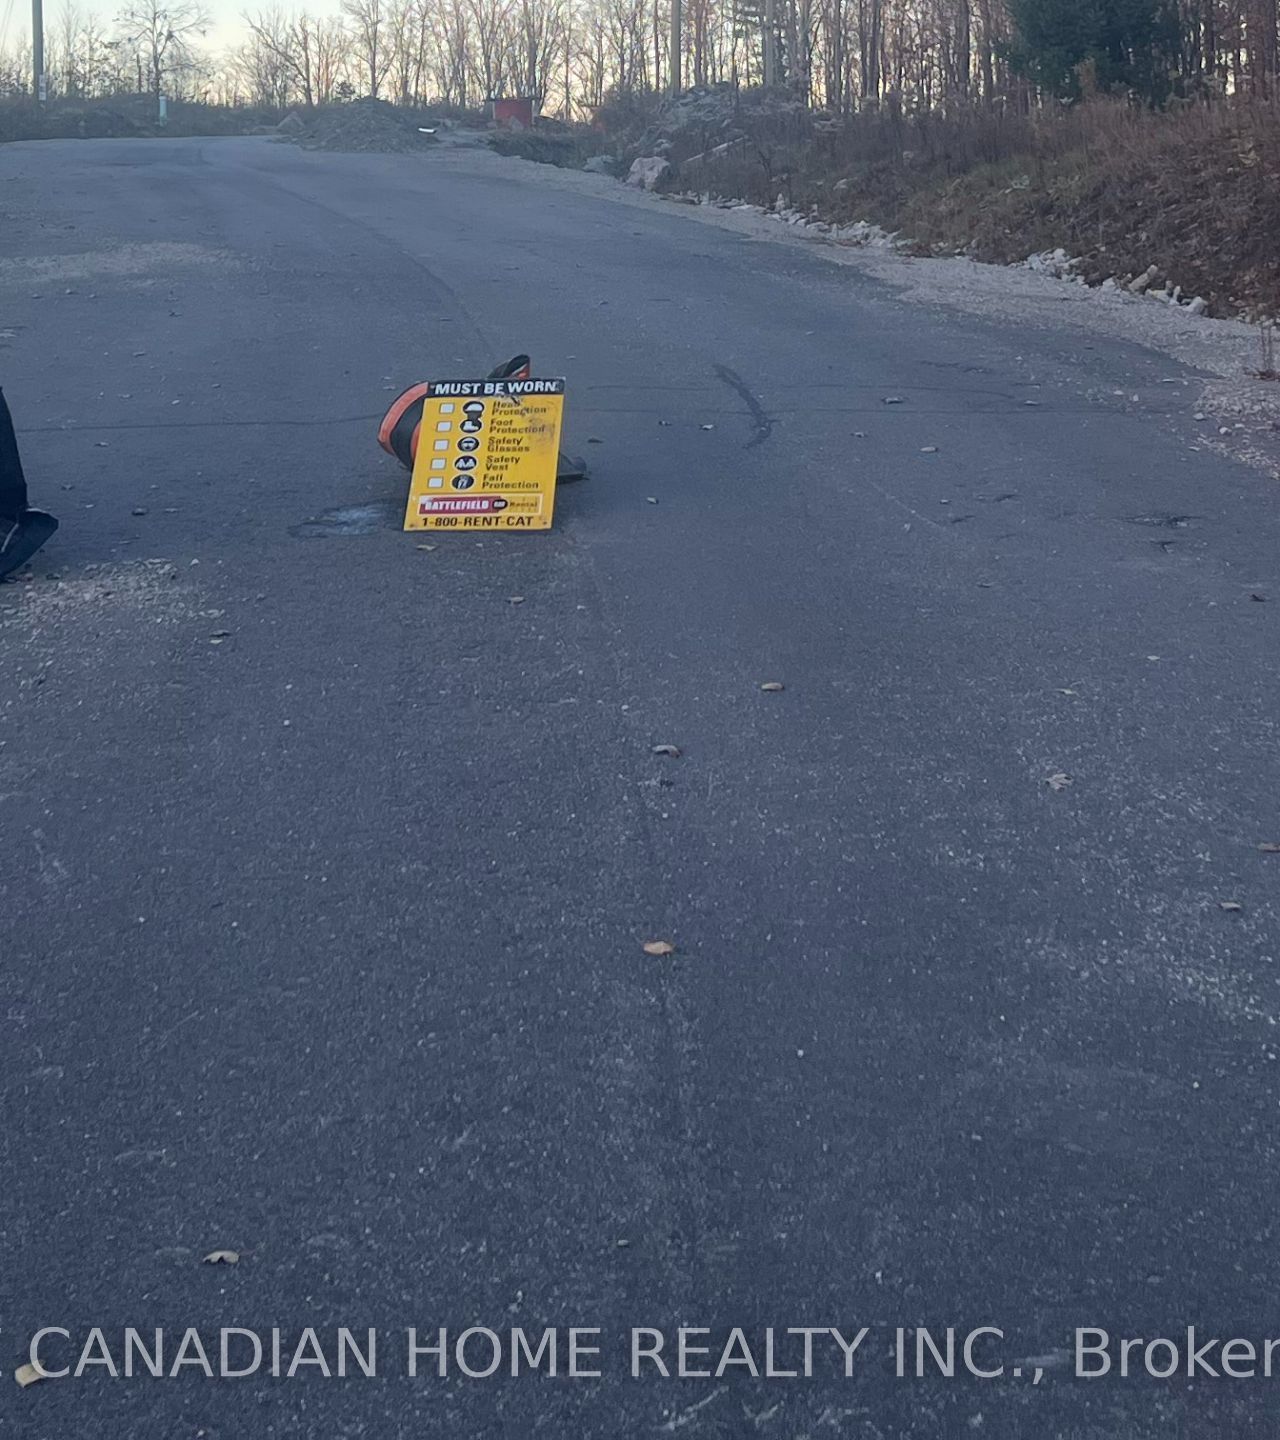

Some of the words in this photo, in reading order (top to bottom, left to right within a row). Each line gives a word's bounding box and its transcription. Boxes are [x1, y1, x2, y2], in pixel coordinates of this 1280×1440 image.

[435, 383, 480, 395] MUST
[484, 382, 504, 394] BE
[508, 381, 556, 393] WORN
[490, 418, 513, 426] Foot
[489, 424, 545, 433] Protection
[488, 436, 524, 446] Safety
[487, 444, 530, 452] Glasses
[486, 455, 521, 464] Safety
[486, 463, 509, 471] Vest
[483, 473, 503, 482] Fall
[482, 480, 539, 489] Protection
[424, 499, 489, 510] BATTLEFIELD
[422, 516, 534, 527] 1-800-RENT-CAT
